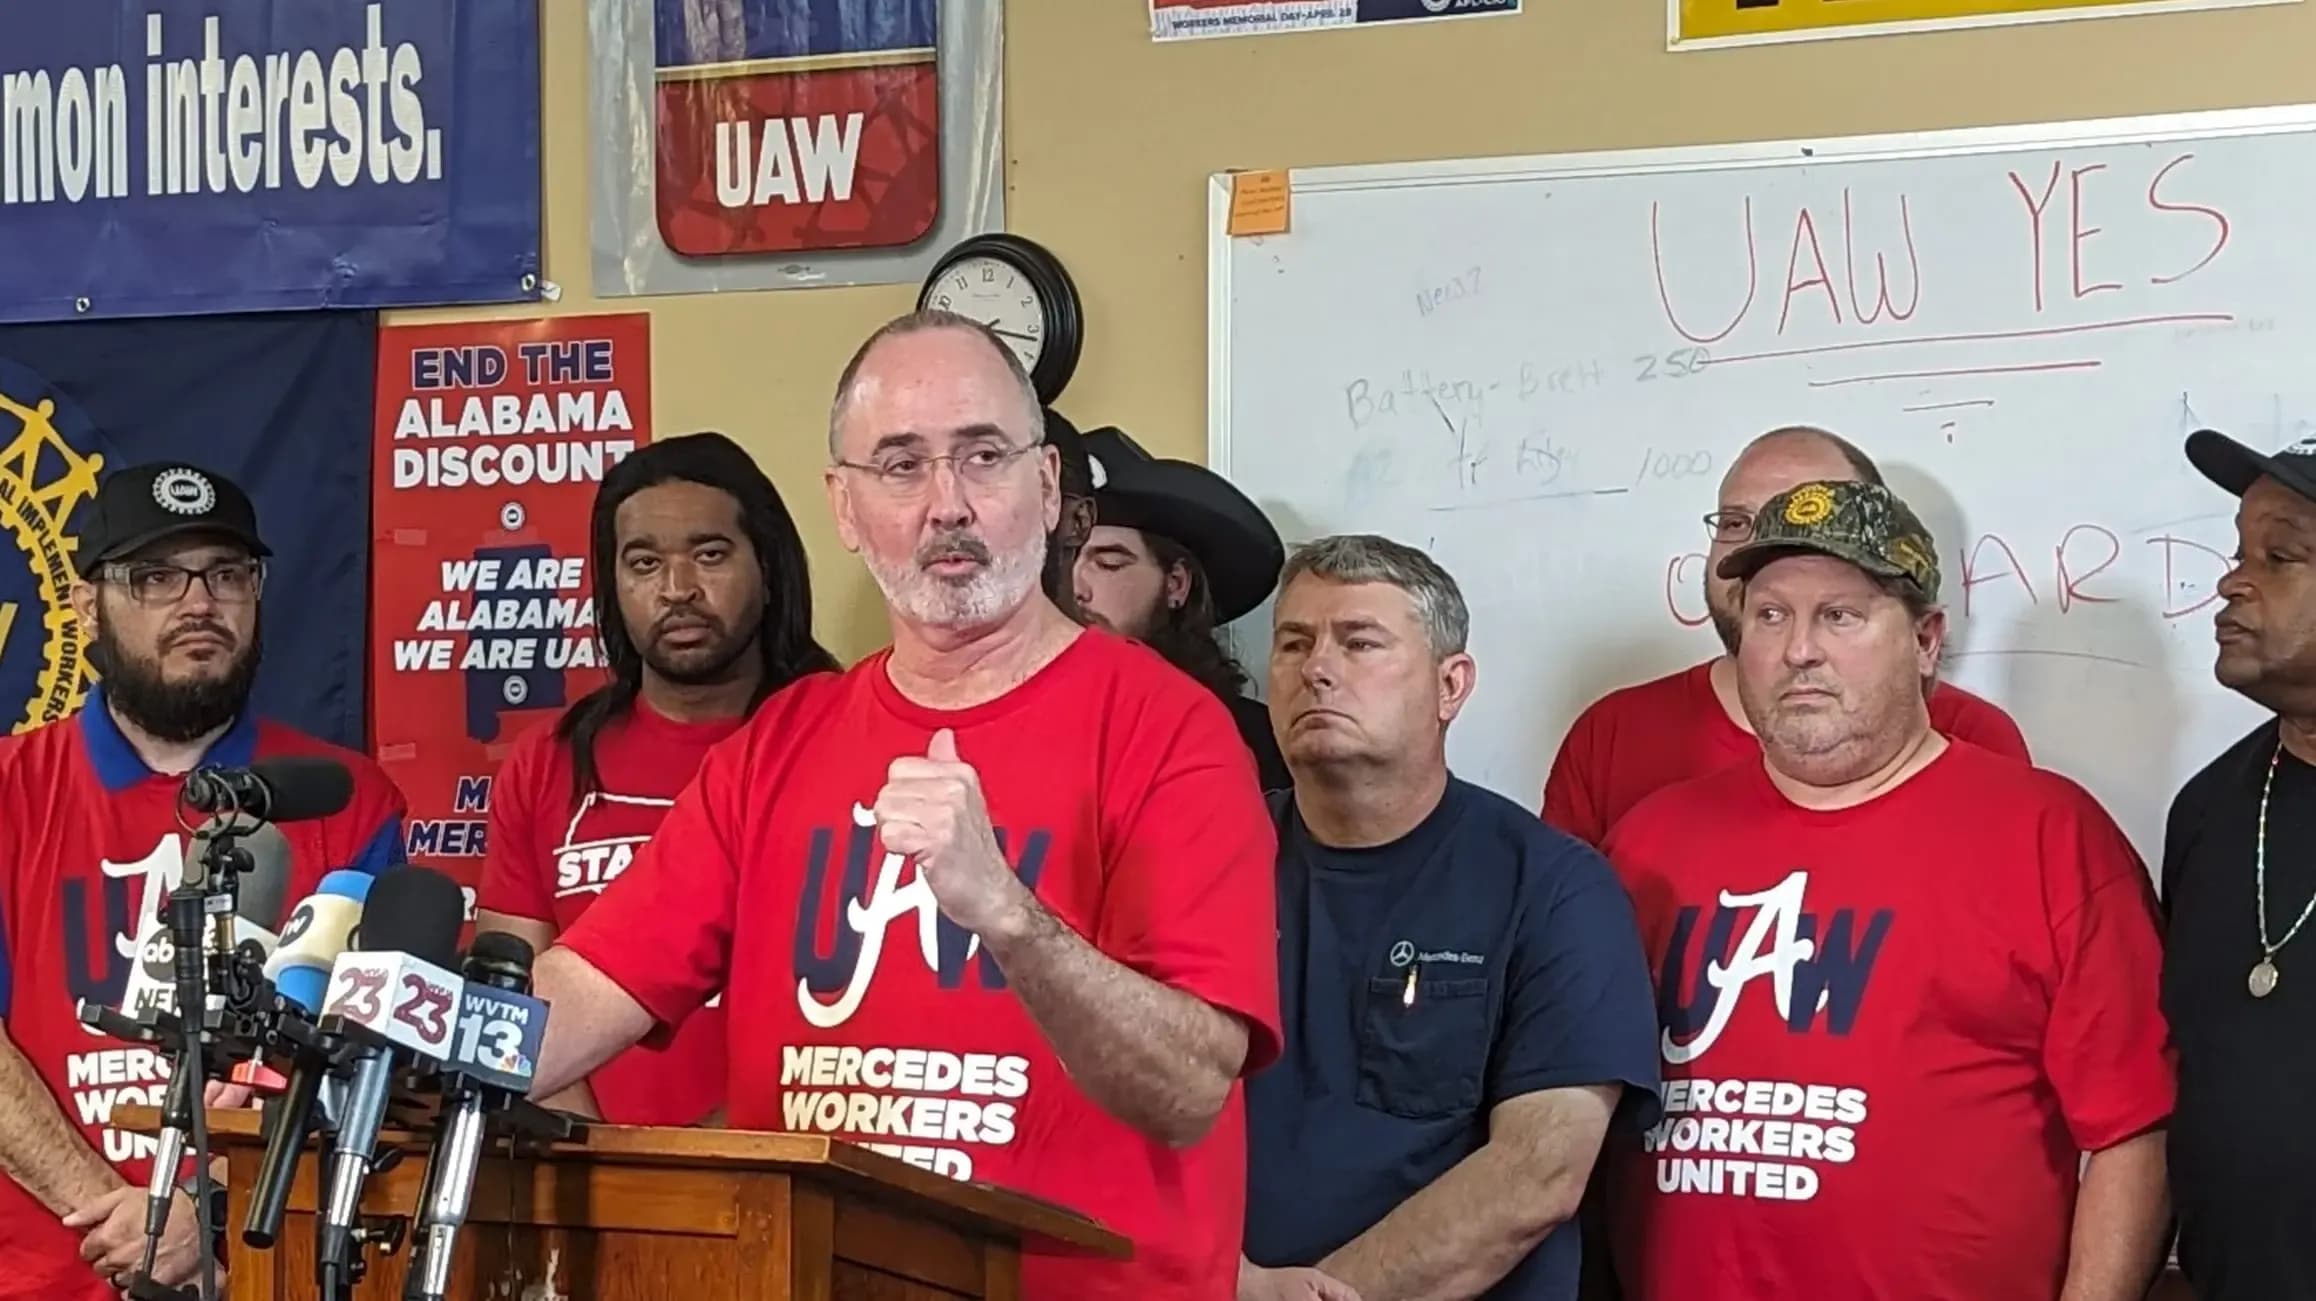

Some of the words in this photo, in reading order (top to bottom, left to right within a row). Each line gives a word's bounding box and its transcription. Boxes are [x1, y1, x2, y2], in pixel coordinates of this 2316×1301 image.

[147, 3, 442, 195] interests.
[715, 112, 864, 208] UAW
[1652, 187, 1919, 343] UAW
[2009, 154, 2229, 312] YES
[982, 268, 995, 282] 12
[1021, 295, 1034, 308] 2
[1027, 324, 1040, 334] 3
[411, 345, 507, 391] END
[518, 339, 614, 386] THE
[1633, 346, 1712, 384] 250
[394, 389, 633, 440] ALABAMA
[17, 495, 72, 611] IMPLEMENT
[441, 559, 500, 592] WE
[506, 558, 585, 591] ARE
[1667, 524, 2231, 626] OARD
[416, 597, 600, 632] ALABAMA
[42, 619, 78, 723] WORKERS
[393, 640, 454, 671] WE
[460, 638, 536, 670] ARE
[558, 844, 634, 887] STA
[1660, 870, 1896, 1064] UAW
[329, 967, 389, 1024] 23
[393, 973, 454, 1045] 23
[465, 994, 529, 1025] WVTM
[458, 1013, 524, 1070] 13
[780, 1045, 1030, 1097] MERCEDES
[782, 1091, 1016, 1144] WORKERS
[1660, 1079, 1868, 1124] ERCEDES
[1644, 1117, 1856, 1162] WORKERS
[1656, 1158, 1819, 1200] UNITED
